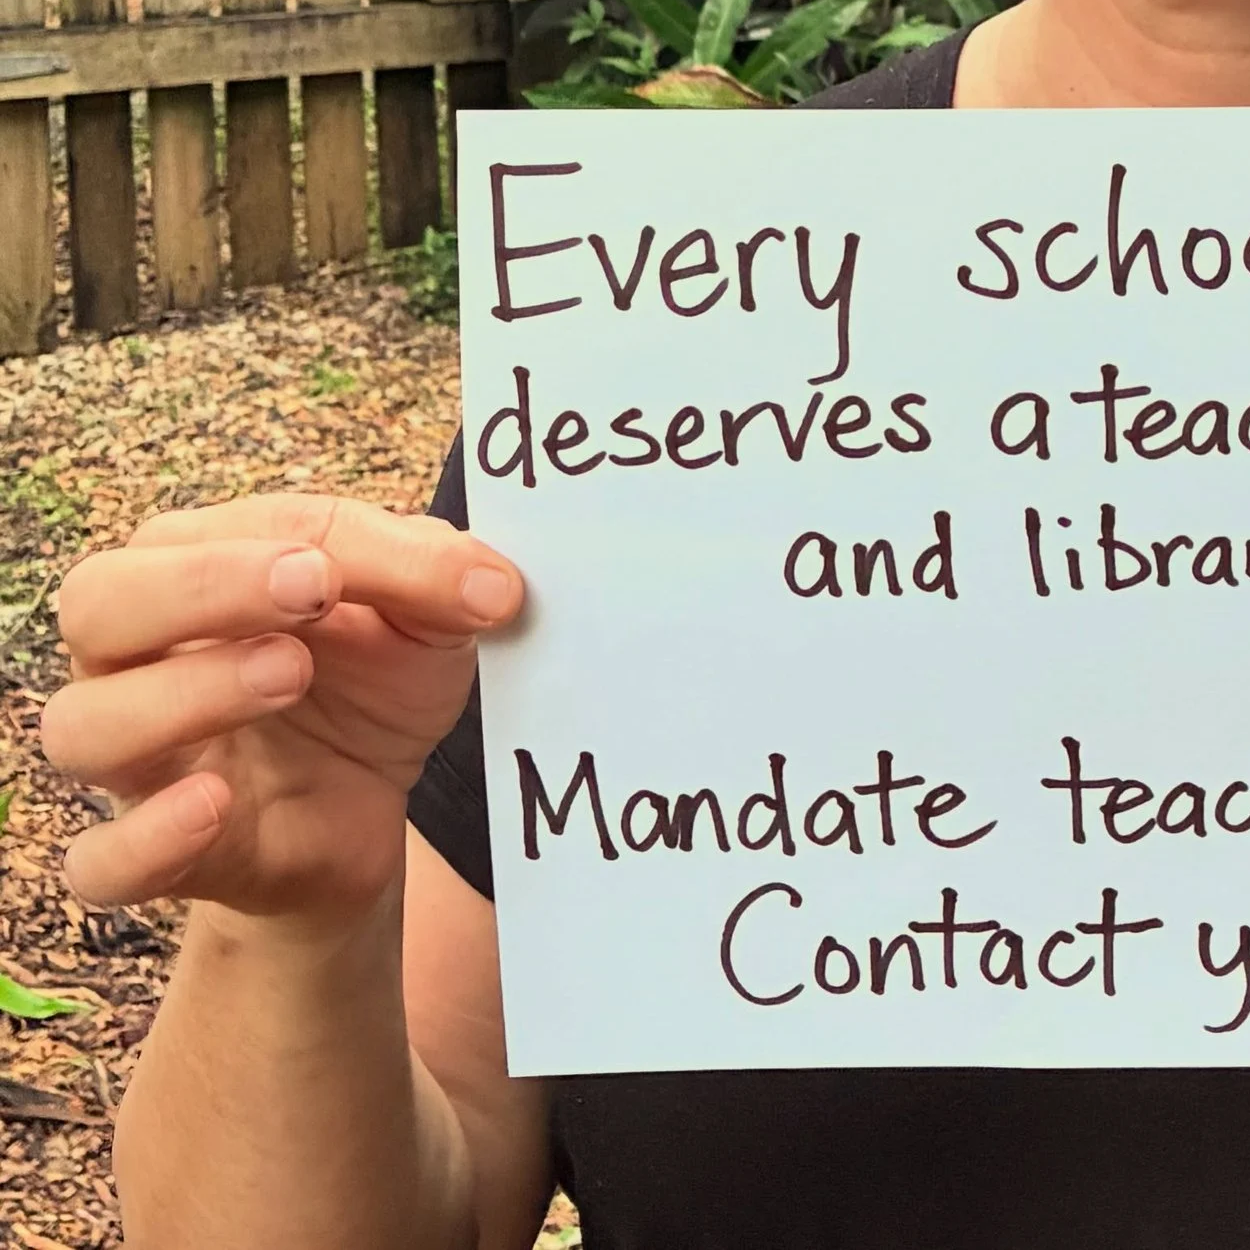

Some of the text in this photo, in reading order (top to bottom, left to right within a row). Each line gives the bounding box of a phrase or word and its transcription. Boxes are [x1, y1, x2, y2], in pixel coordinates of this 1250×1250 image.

[488, 161, 862, 387] Every
[476, 364, 933, 490] deserves
[989, 391, 1052, 462] a
[782, 509, 960, 601] and
[512, 747, 999, 862] Mandate
[719, 881, 1165, 1007] Contact
